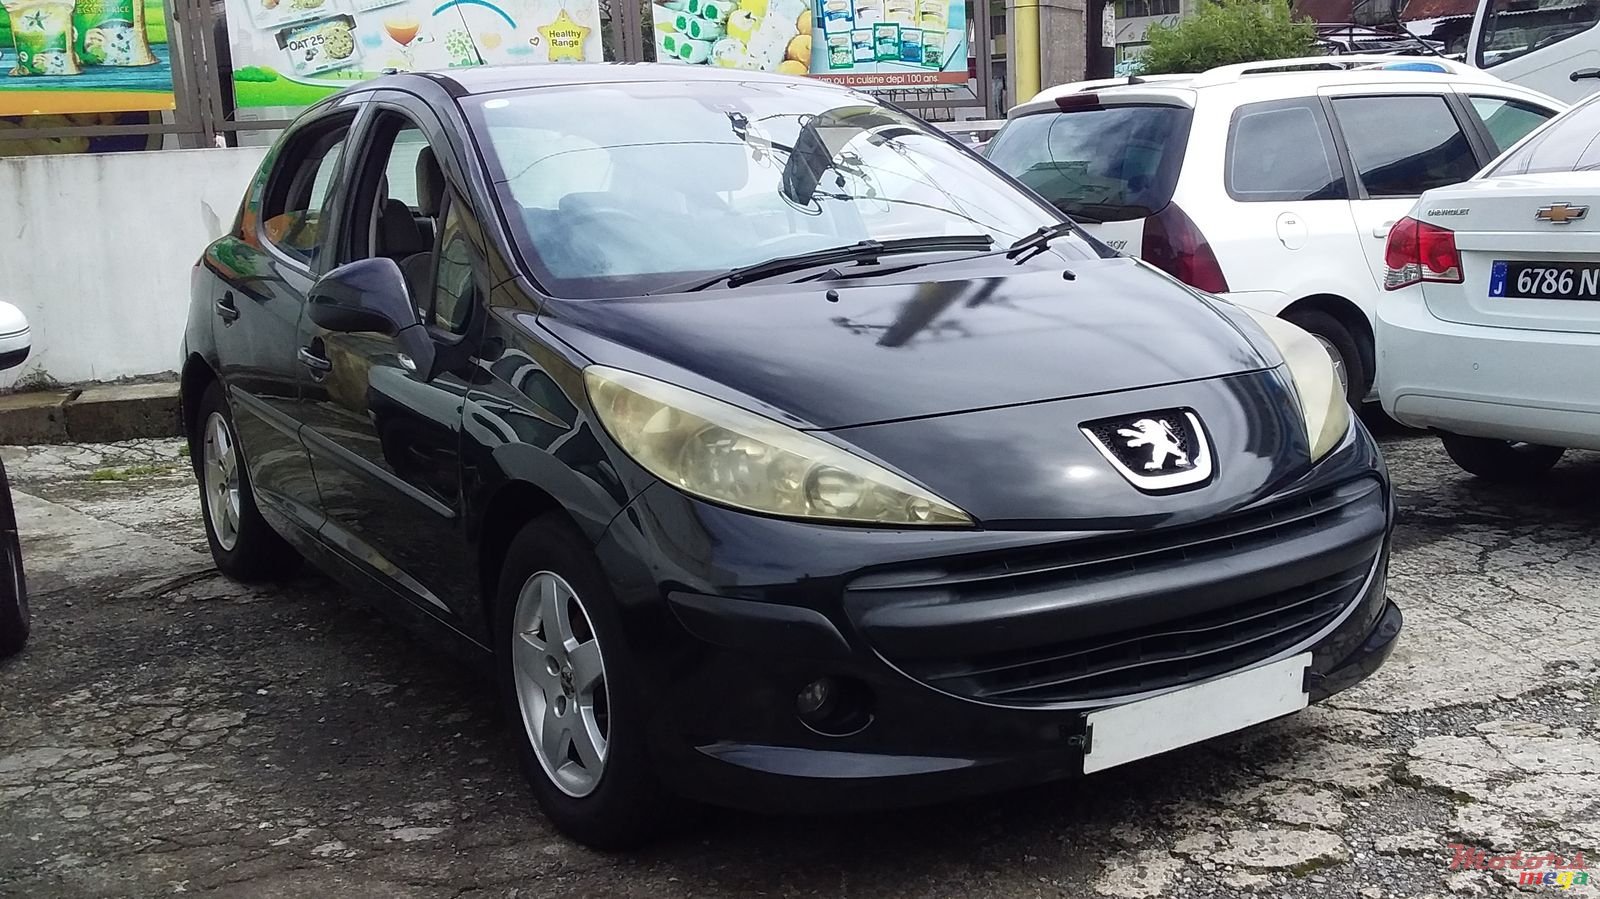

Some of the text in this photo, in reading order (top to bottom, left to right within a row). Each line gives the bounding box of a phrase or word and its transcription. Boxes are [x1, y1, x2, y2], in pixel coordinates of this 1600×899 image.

[549, 30, 581, 38] Healthy
[289, 34, 325, 51] OAT 25
[551, 39, 579, 47] Range
[846, 76, 855, 84] la
[856, 75, 884, 84] cuisine
[886, 74, 905, 85] depi
[907, 74, 922, 83] 100
[1427, 208, 1470, 217] CHEVROLET
[1517, 268, 1574, 295] 6786
[1493, 281, 1503, 295] J
